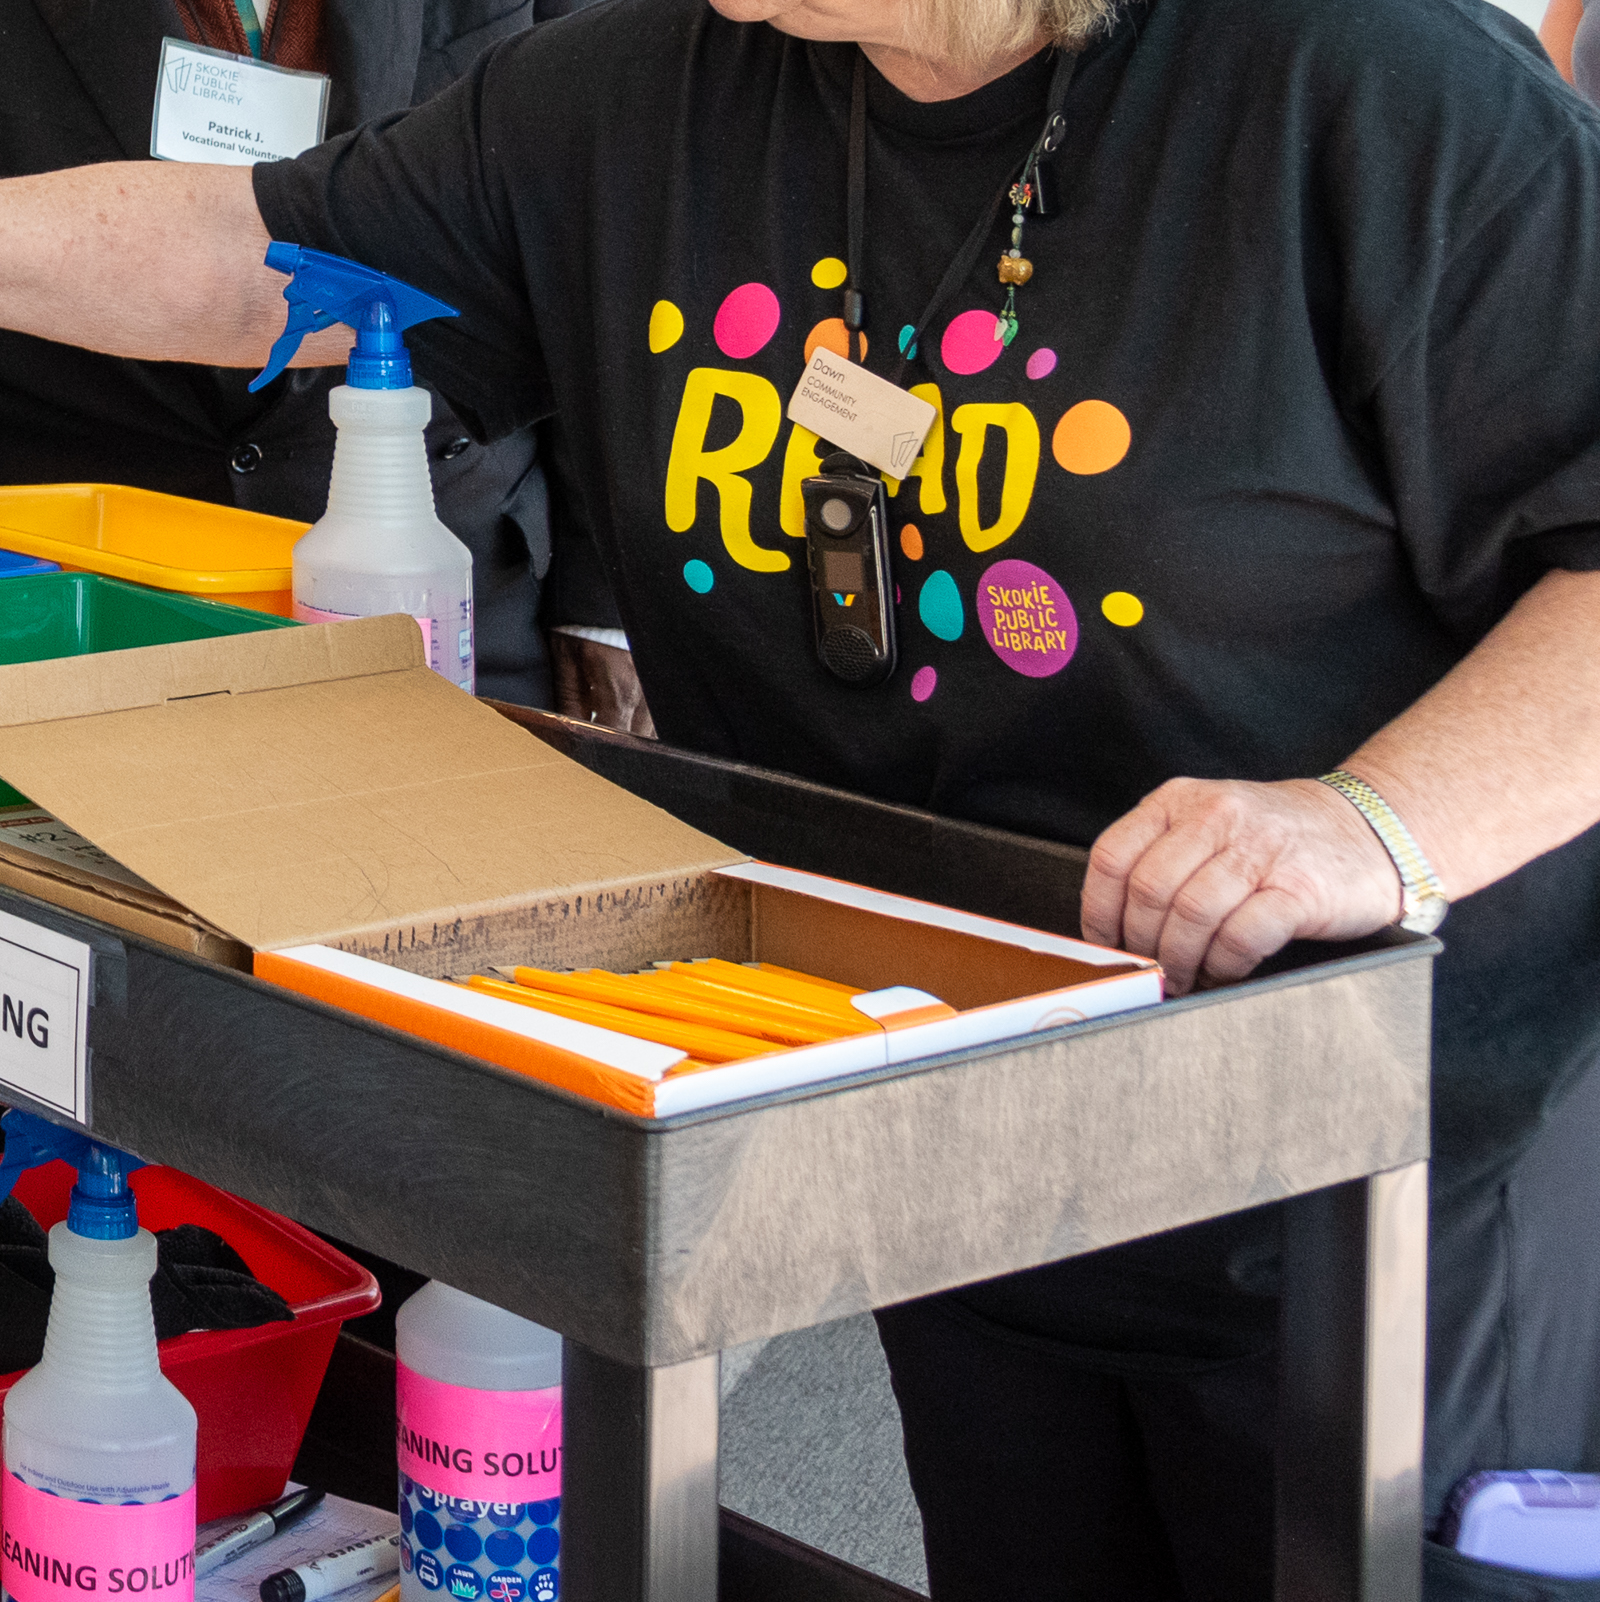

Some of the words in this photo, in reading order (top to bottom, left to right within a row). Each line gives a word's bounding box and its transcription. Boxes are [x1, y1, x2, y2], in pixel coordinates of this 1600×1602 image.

[196, 62, 240, 82] SKOKIE
[194, 74, 237, 93] PUBLIC
[193, 86, 243, 105] LIBRARY
[208, 121, 252, 140] Patrick
[255, 132, 264, 143] J.
[182, 131, 235, 151] Vocational
[238, 144, 286, 162] Voluntee
[811, 353, 847, 385] Dawn
[804, 374, 858, 408] COMMUNITY
[799, 385, 859, 424] ENGAGEMENT
[399, 1424, 472, 1473] ANING
[484, 1447, 562, 1476] SOLU
[420, 1553, 436, 1565] AUTO
[108, 1551, 195, 1593] SOLUTI
[453, 1569, 474, 1579] LAWN
[491, 1576, 522, 1584] GARDEN
